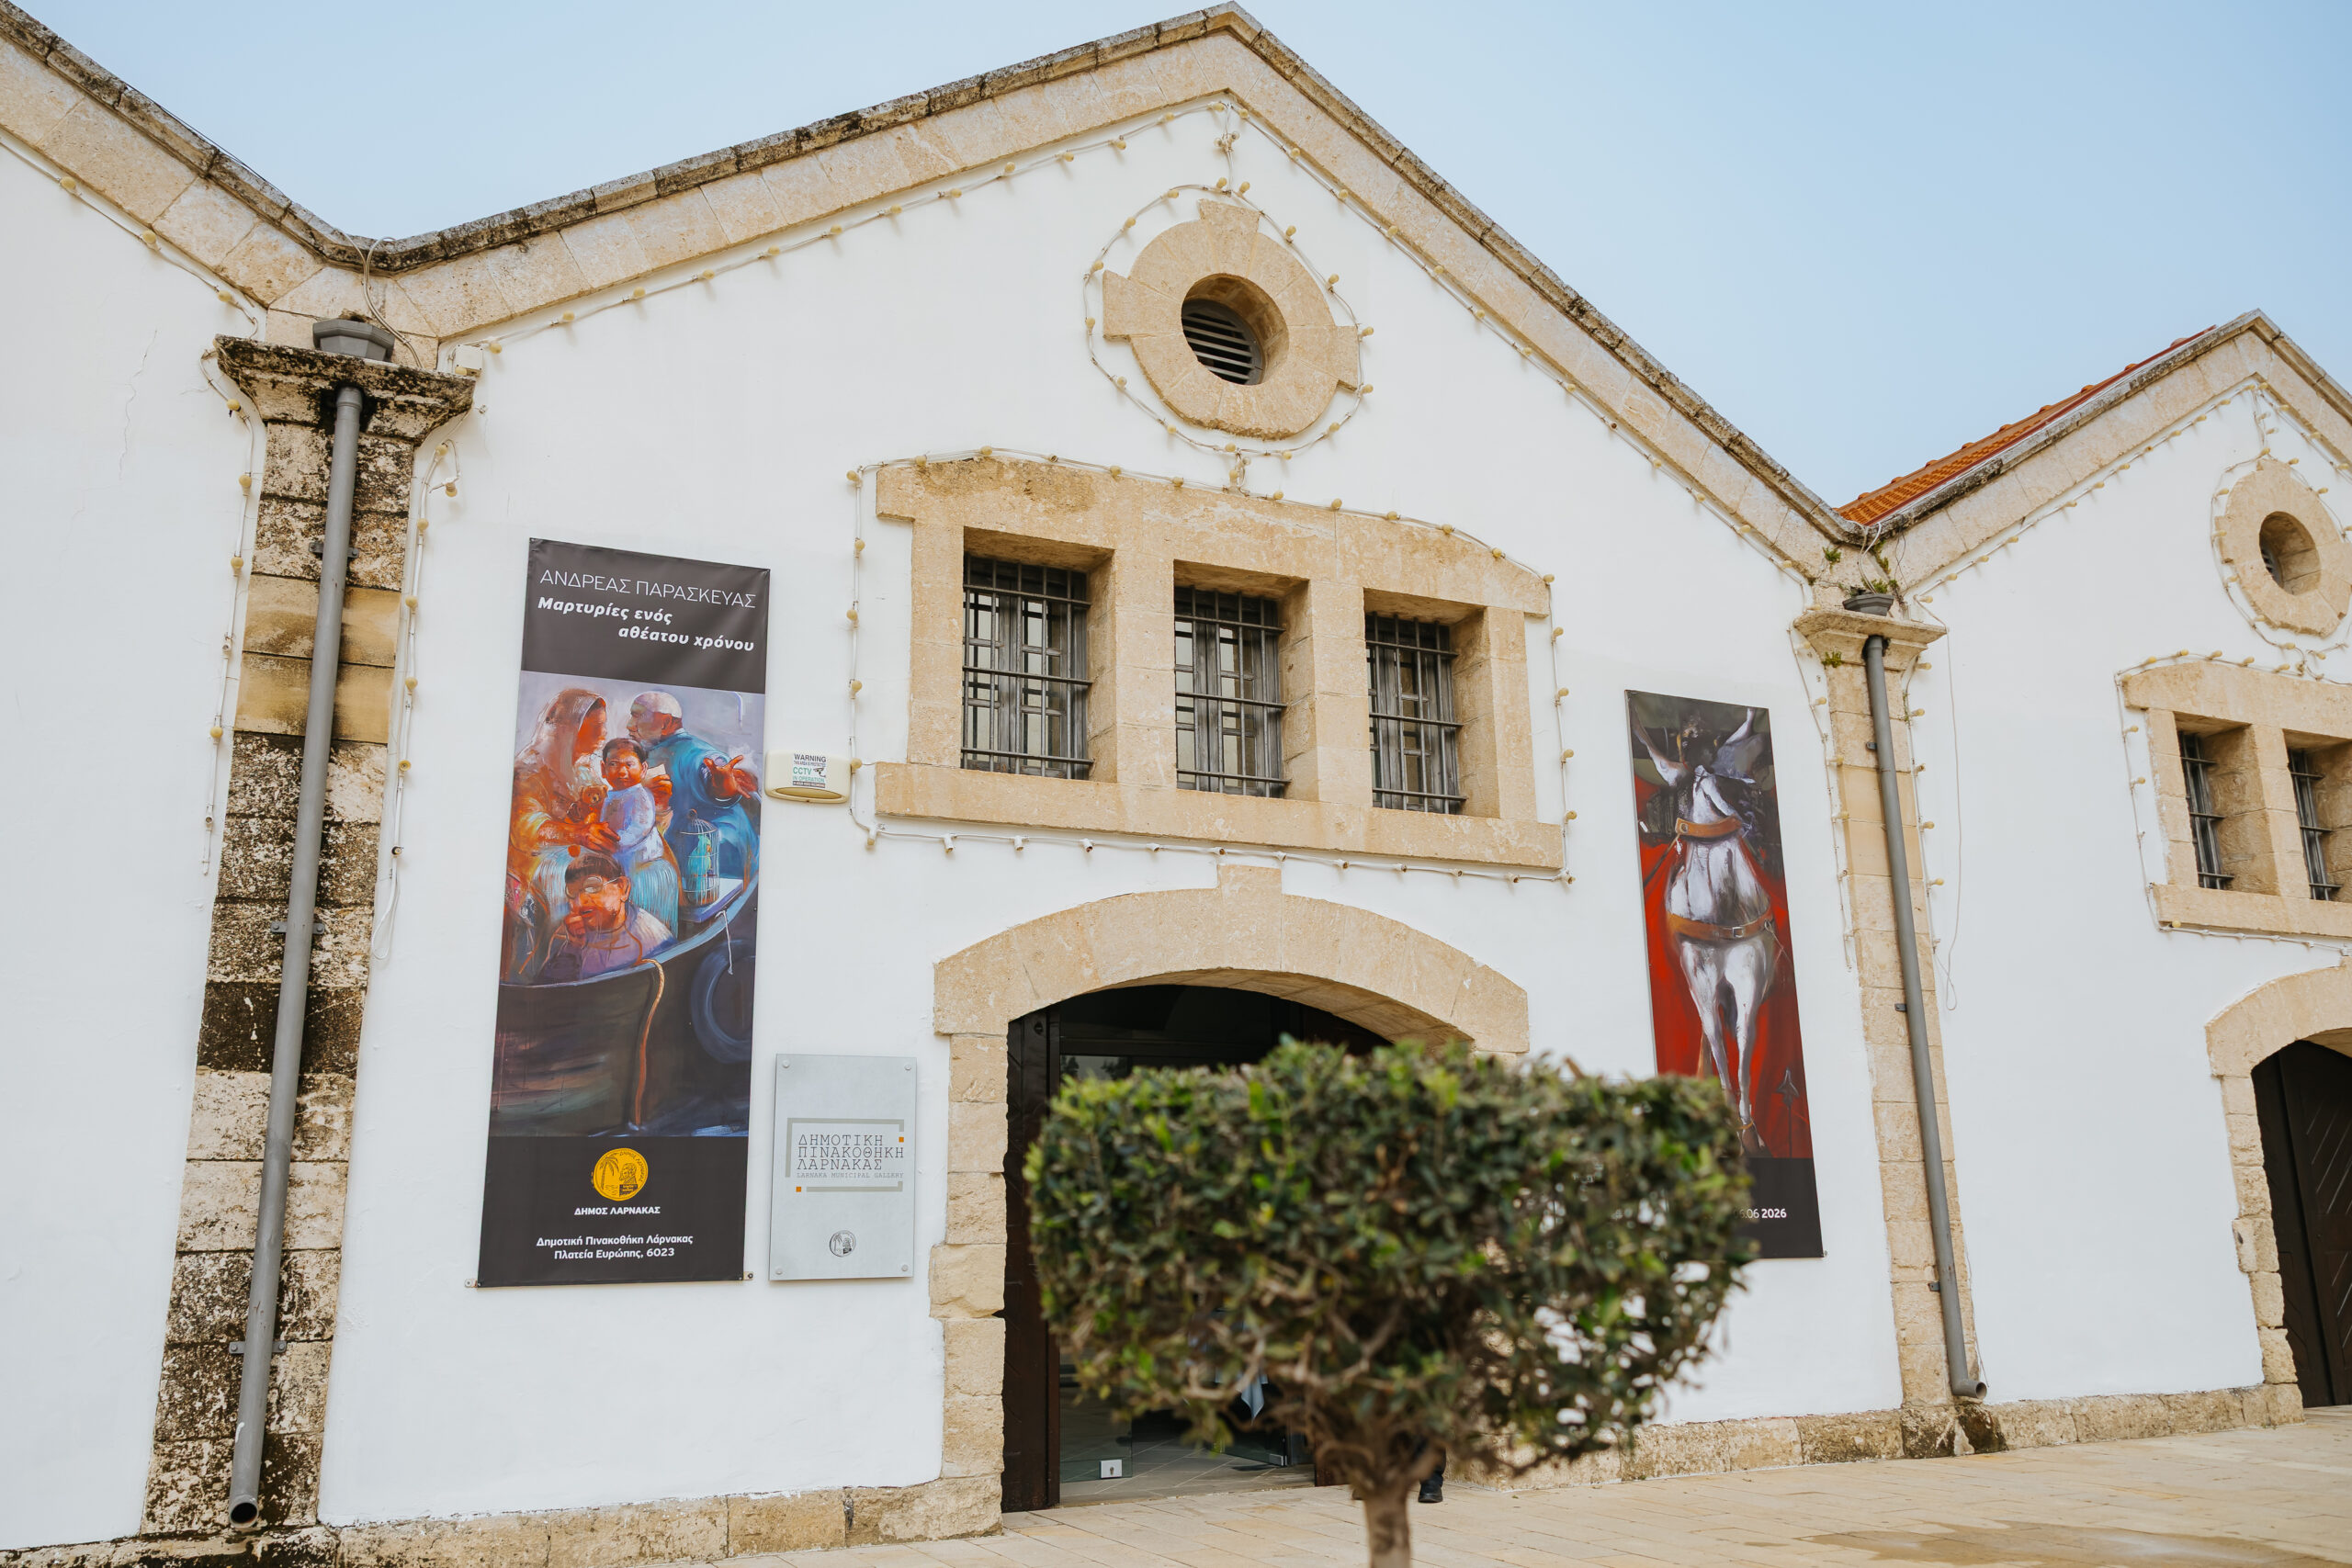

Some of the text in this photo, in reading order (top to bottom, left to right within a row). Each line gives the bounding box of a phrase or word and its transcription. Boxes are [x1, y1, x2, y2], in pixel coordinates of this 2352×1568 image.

[539, 570, 756, 609] ΑΝΔΡΕΑΣ ΠΑΡΑΣΚΕΥΑΣ
[537, 596, 673, 625] Μαρτυρίες ενός
[618, 626, 754, 652] αθέατου χρόνου
[794, 753, 826, 762] WARNING
[793, 766, 812, 775] CCTV
[798, 1134, 883, 1146] ΔΗΜΟΤΙΚΗ
[798, 1146, 904, 1158] ΠΙΝΑΚΟΘΗΚΗ
[797, 1158, 882, 1170] ΛΑΡΝΑΚΑΣ
[573, 1206, 661, 1216] ΔΗΜΟΣ ΛΑΡΝΑΚΑΣ
[1761, 1208, 1787, 1219] 2026
[536, 1234, 694, 1247] Δημοτική Πινακοθήκη Λάρνακας
[554, 1247, 675, 1261] Πλατεία Ευρώπης, 6023
